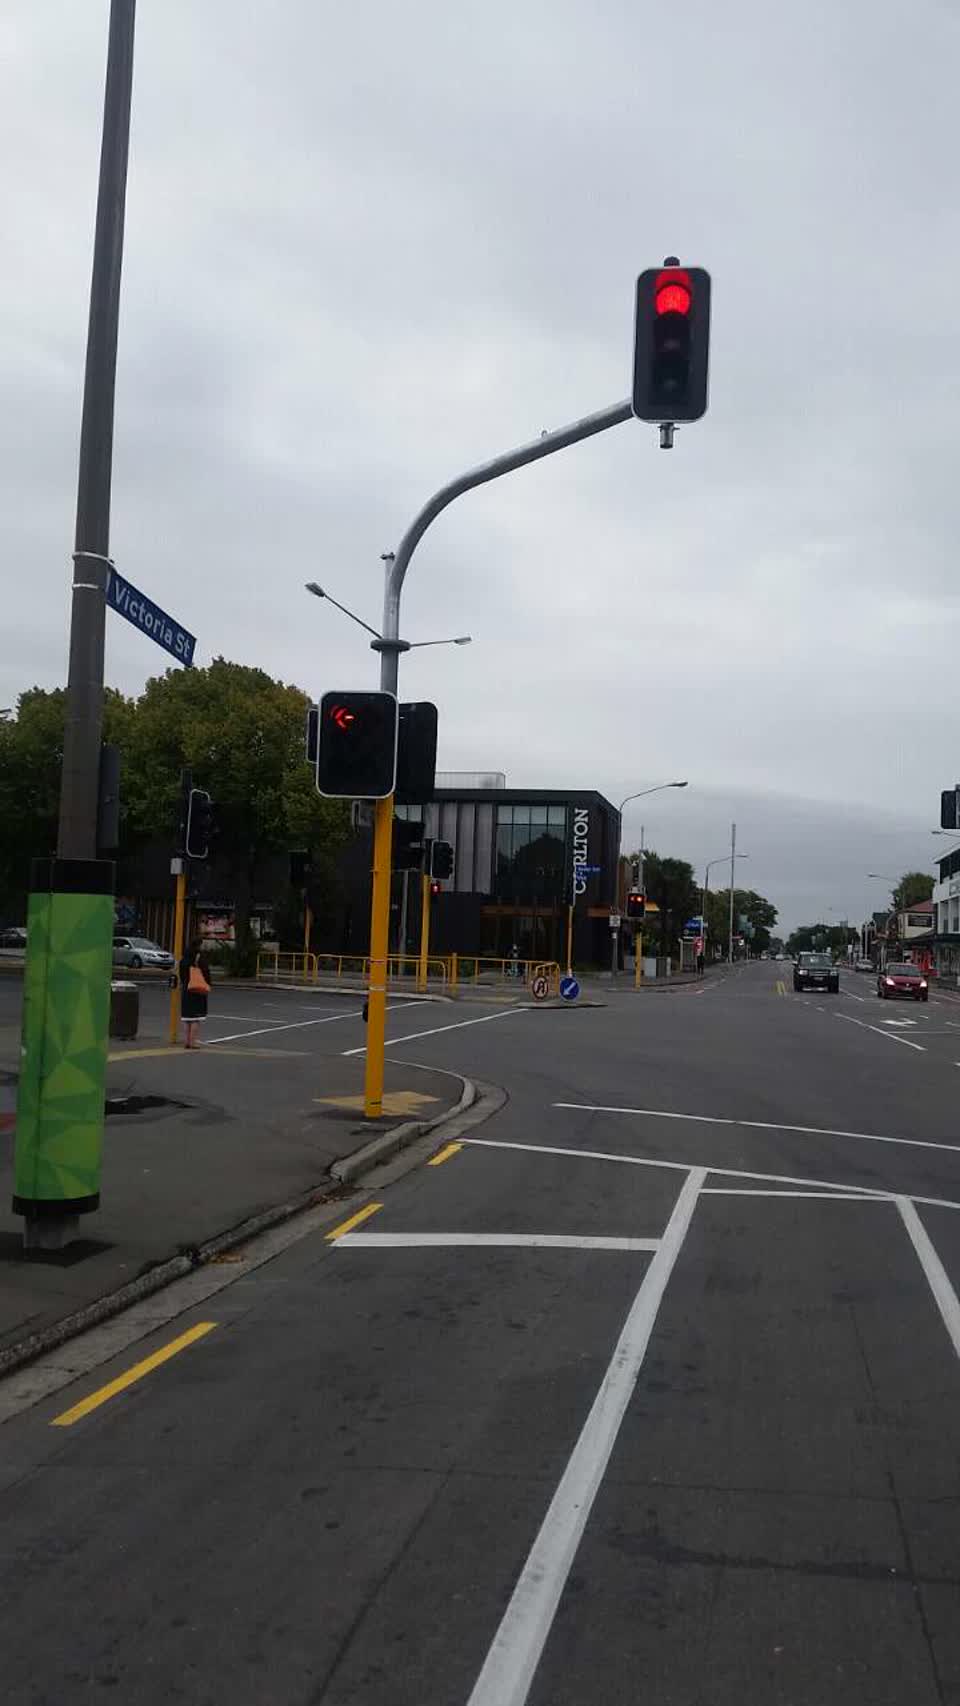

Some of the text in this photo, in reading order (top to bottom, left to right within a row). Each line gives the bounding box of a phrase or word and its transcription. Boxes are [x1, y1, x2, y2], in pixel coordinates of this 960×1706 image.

[114, 580, 191, 658] Victoria St
[573, 807, 589, 895] CRLTON
